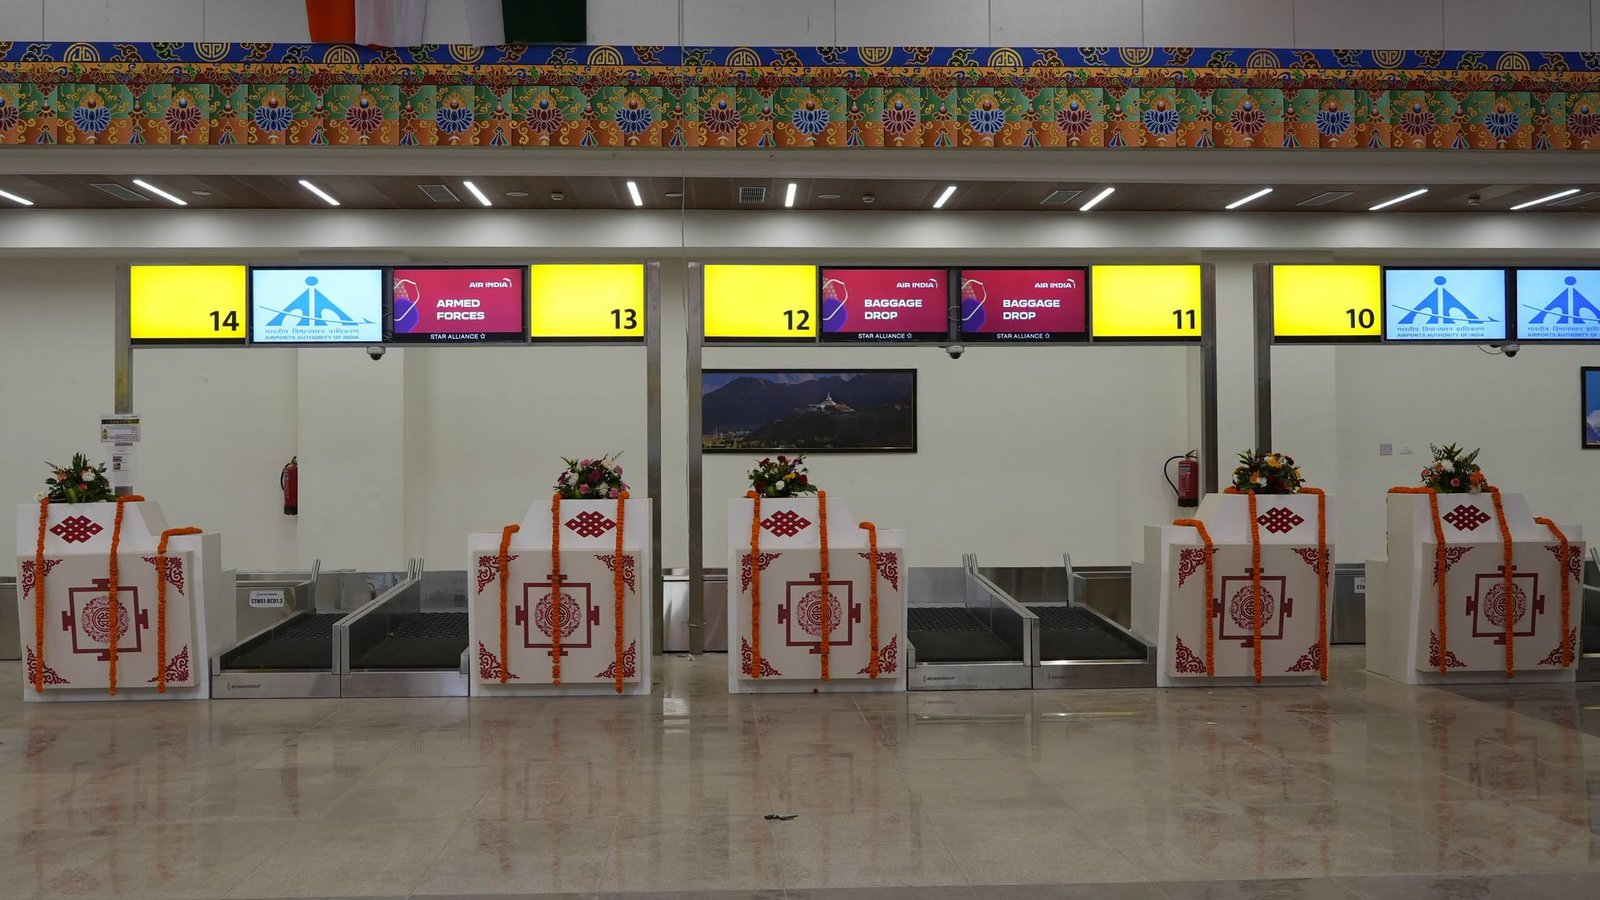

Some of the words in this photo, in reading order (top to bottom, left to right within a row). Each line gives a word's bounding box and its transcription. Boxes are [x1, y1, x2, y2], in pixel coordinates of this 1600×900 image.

[436, 299, 481, 308] ARMED
[864, 299, 923, 308] BAGGAGE
[1002, 299, 1061, 308] BAGGAGE
[436, 311, 485, 320] FORCES
[610, 308, 638, 330] 13
[783, 309, 810, 331] 12
[864, 311, 898, 320] DROP
[1002, 311, 1037, 320] DROP
[1172, 309, 1196, 330] 11
[1346, 308, 1375, 329] 10
[209, 310, 239, 332] 14
